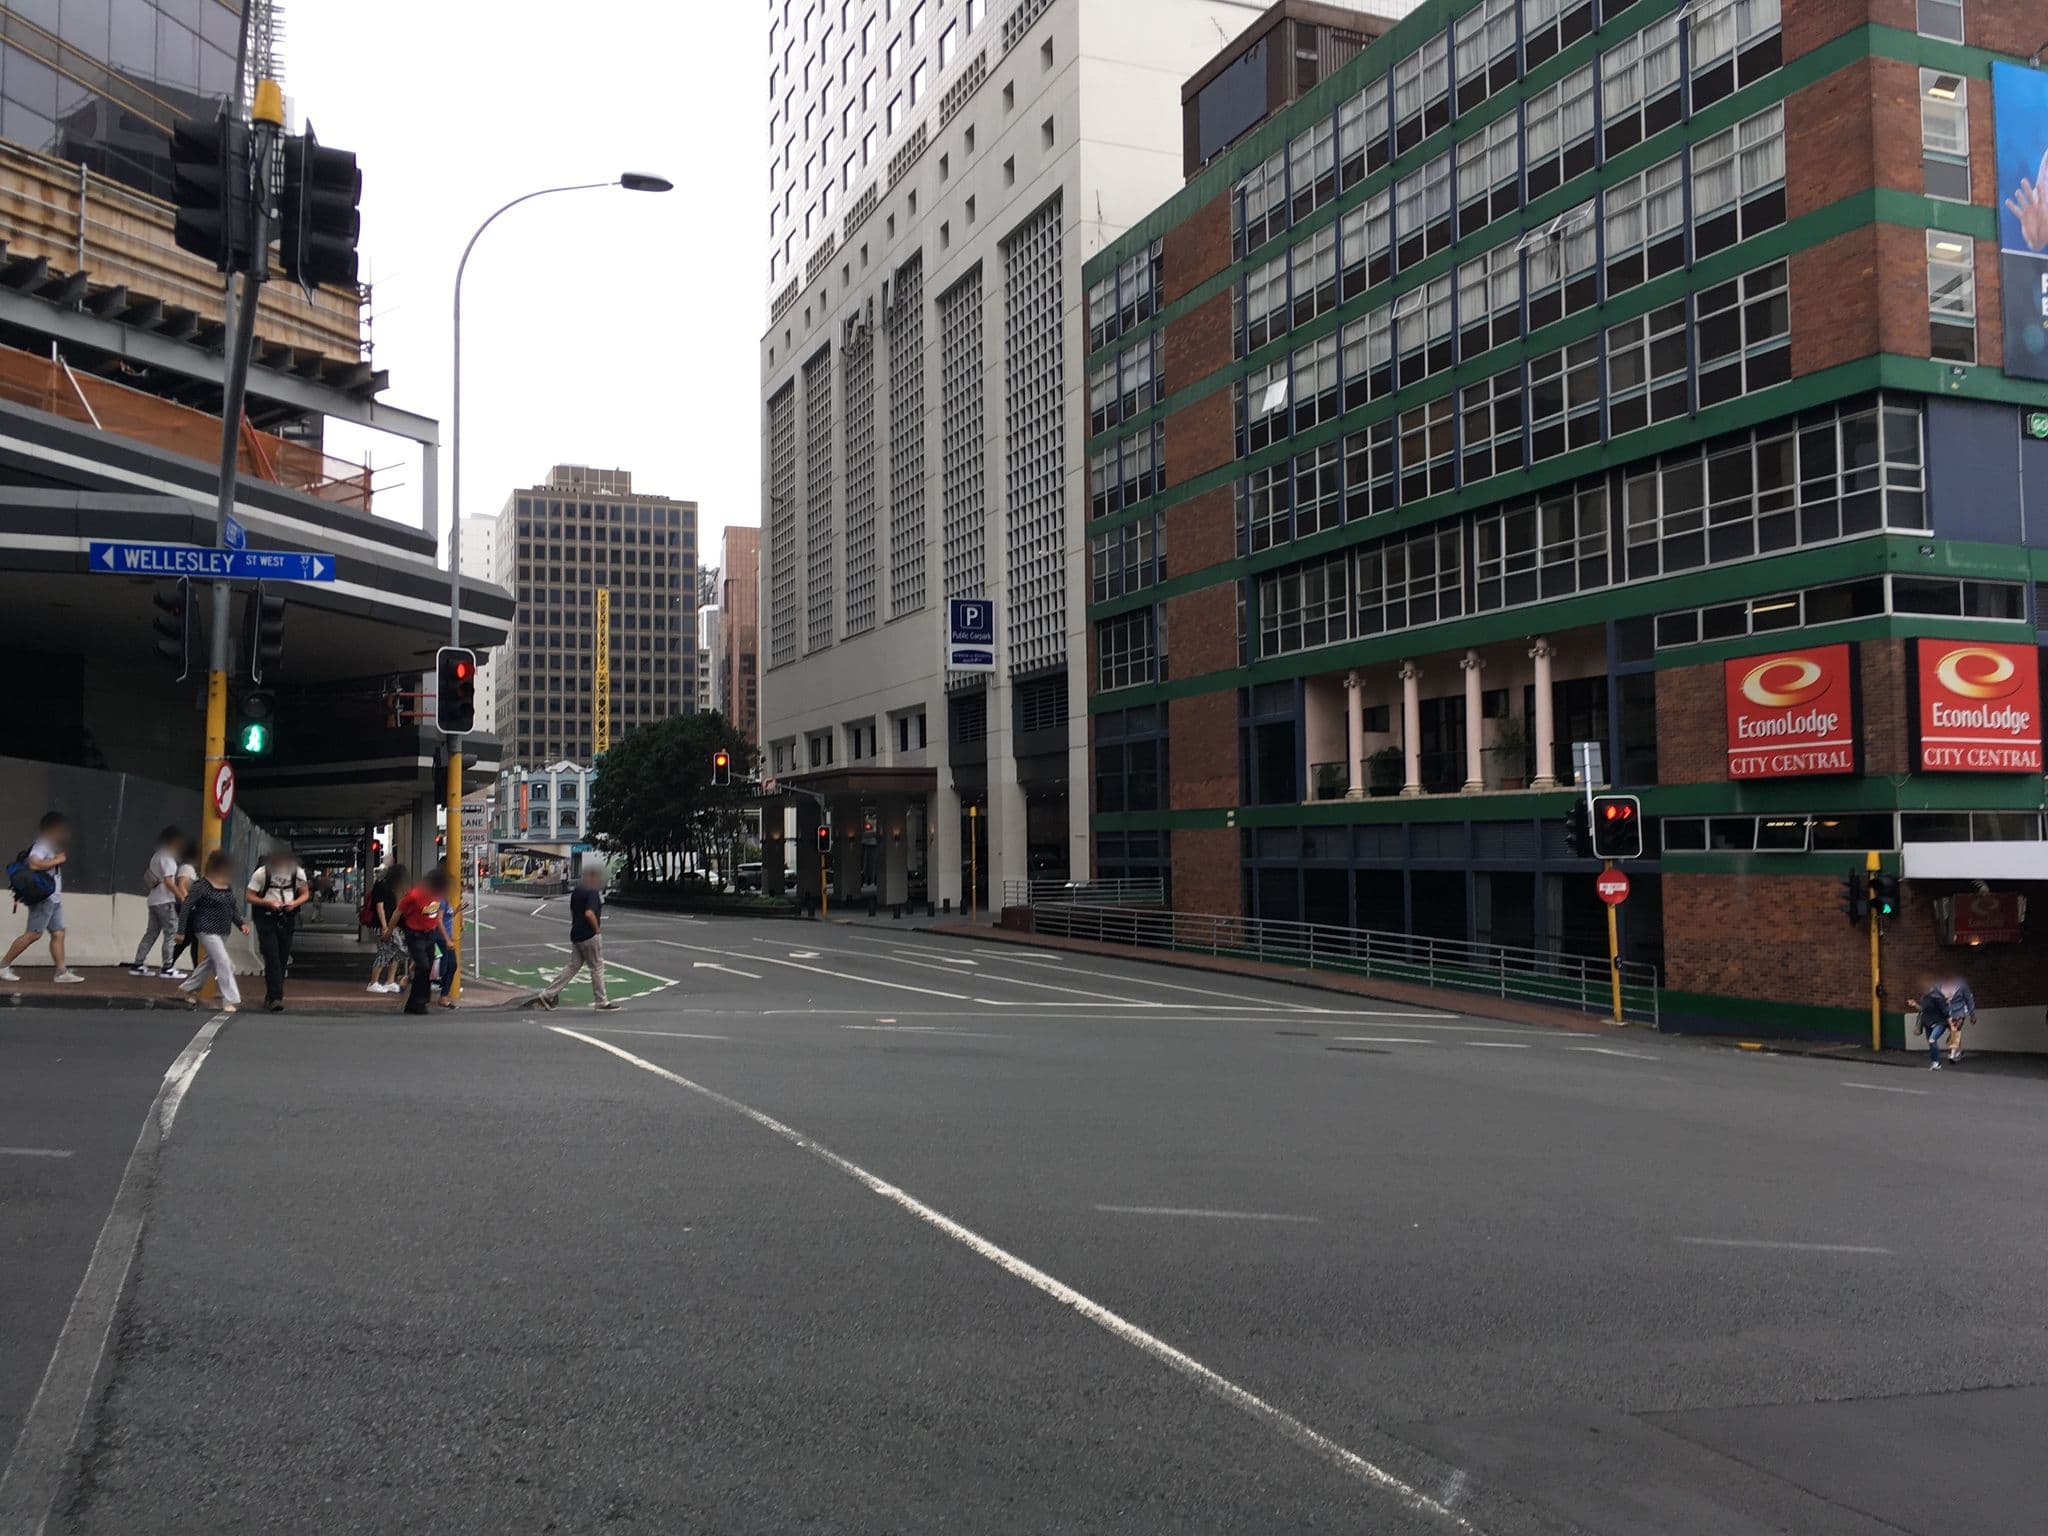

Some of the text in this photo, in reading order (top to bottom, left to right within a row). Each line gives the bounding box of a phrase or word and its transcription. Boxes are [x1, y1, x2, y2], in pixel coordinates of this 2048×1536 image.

[124, 549, 285, 573] WELLESLEY ST WEST
[300, 555, 311, 564] 37
[966, 607, 978, 626] P
[1738, 708, 1839, 739] EconoLodge
[1932, 701, 2031, 735] EconoLodge
[1729, 750, 1853, 775] CITY CENTRAL
[1923, 747, 2041, 768] CITY CENTRAL
[462, 819, 483, 827] ANE
